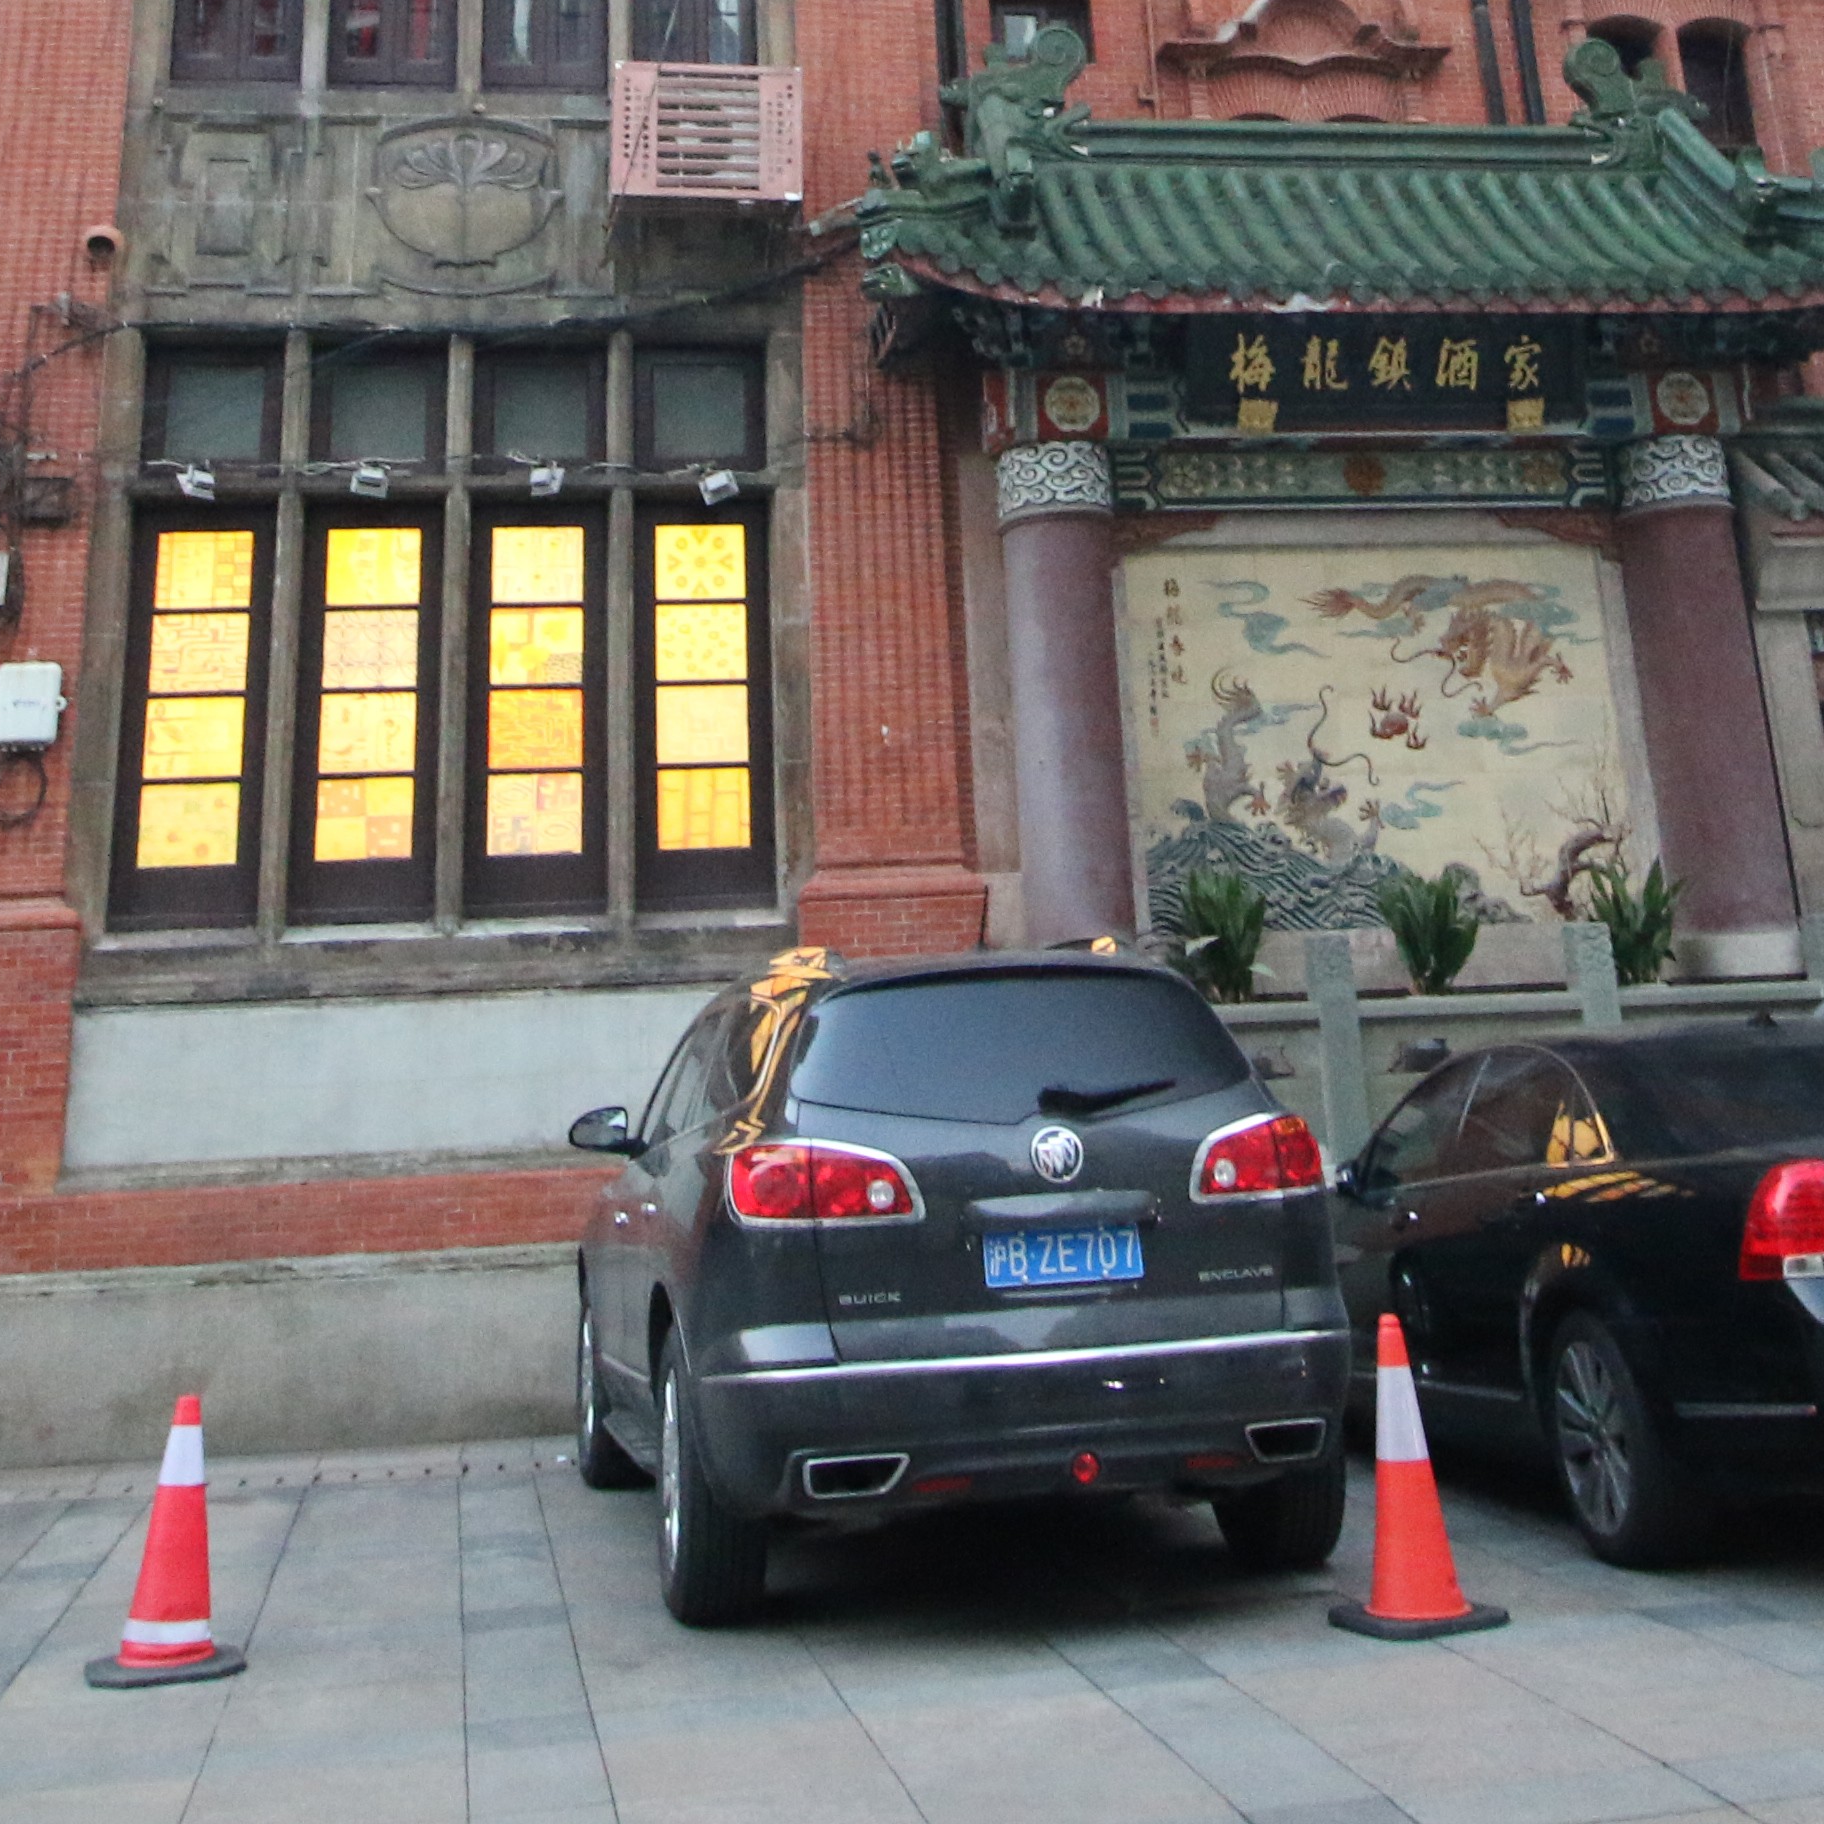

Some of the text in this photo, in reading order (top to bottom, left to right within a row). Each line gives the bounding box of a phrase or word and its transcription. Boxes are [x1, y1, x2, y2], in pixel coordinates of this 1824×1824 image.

[1229, 332, 1541, 392] 梅龍鎮酒家
